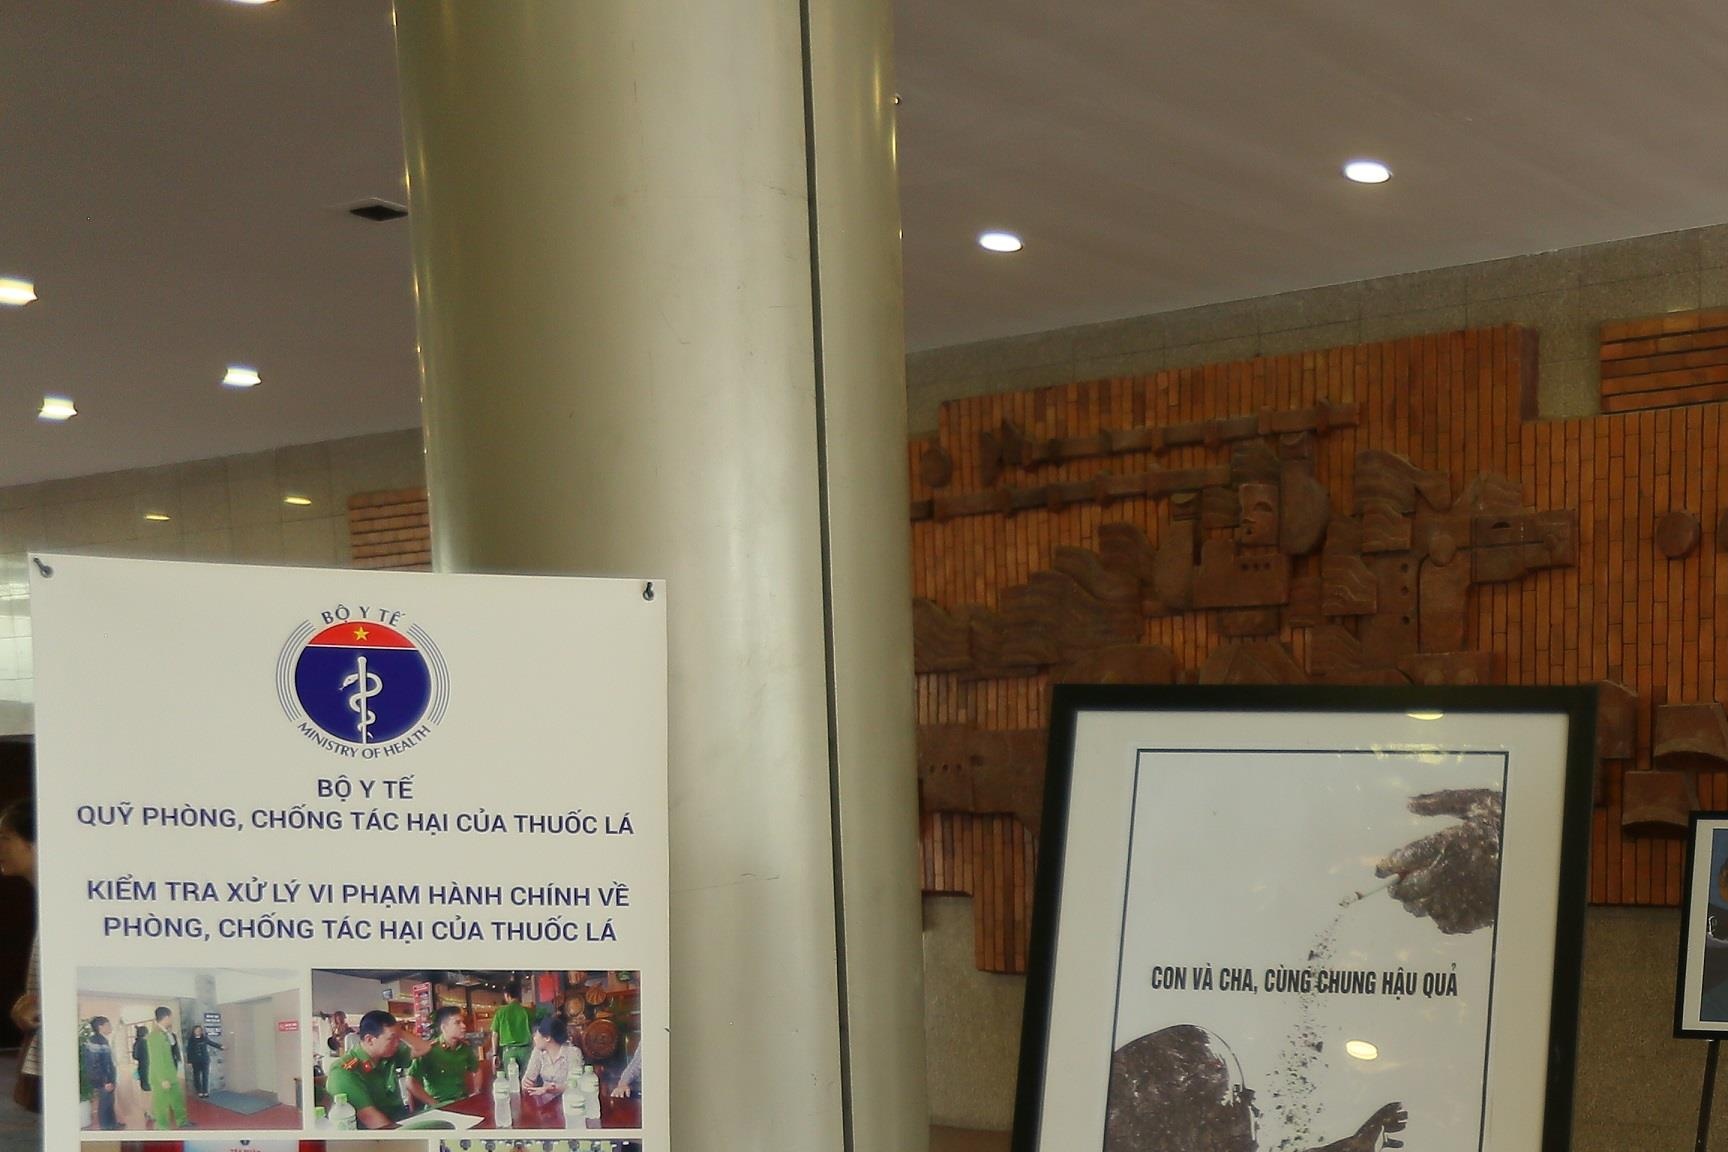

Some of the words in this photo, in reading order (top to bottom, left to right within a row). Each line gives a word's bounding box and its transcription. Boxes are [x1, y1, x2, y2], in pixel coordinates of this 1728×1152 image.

[321, 604, 351, 625] BỘ
[359, 606, 370, 619] Y
[379, 608, 406, 627] TẾ
[297, 722, 359, 758] MINISTRY
[361, 748, 381, 759] OF
[384, 725, 431, 757] HEALTH
[317, 774, 352, 802] BỘ
[359, 780, 375, 799] Y
[383, 774, 415, 799] TẾ
[77, 801, 135, 827] QUỸ
[143, 804, 244, 831] PHÒNG,
[251, 803, 343, 830] CHỐNG
[351, 808, 399, 831] TÁC
[407, 813, 449, 836] HẠI
[456, 808, 507, 833] CỦA
[513, 809, 598, 834] THUỐC
[605, 813, 634, 835] LÁ
[87, 874, 157, 901] KIỂM
[165, 882, 219, 902] TRA
[227, 876, 267, 903] XỬ
[272, 879, 301, 903] LÝ
[308, 884, 333, 903] VI
[342, 883, 420, 908] PHẠM
[429, 881, 502, 905] HÀNH
[510, 882, 591, 906] CHÍNH
[597, 880, 630, 907] VỀ
[104, 913, 210, 941] PHÒNG,
[218, 911, 314, 939] CHỐNG
[322, 916, 372, 939] TÁC
[380, 920, 423, 944] HẠI
[432, 914, 484, 941] CỦA
[491, 915, 579, 942] THUỐC
[586, 918, 617, 942] LÁ
[1151, 965, 1187, 990] CON
[1192, 962, 1213, 991] VÀ
[1219, 966, 1258, 995] CHA,
[1264, 963, 1312, 993] CÙNG
[1317, 968, 1376, 994] CHUNG
[1382, 966, 1417, 1000] HẬU
[1423, 962, 1458, 998] QUẢ
